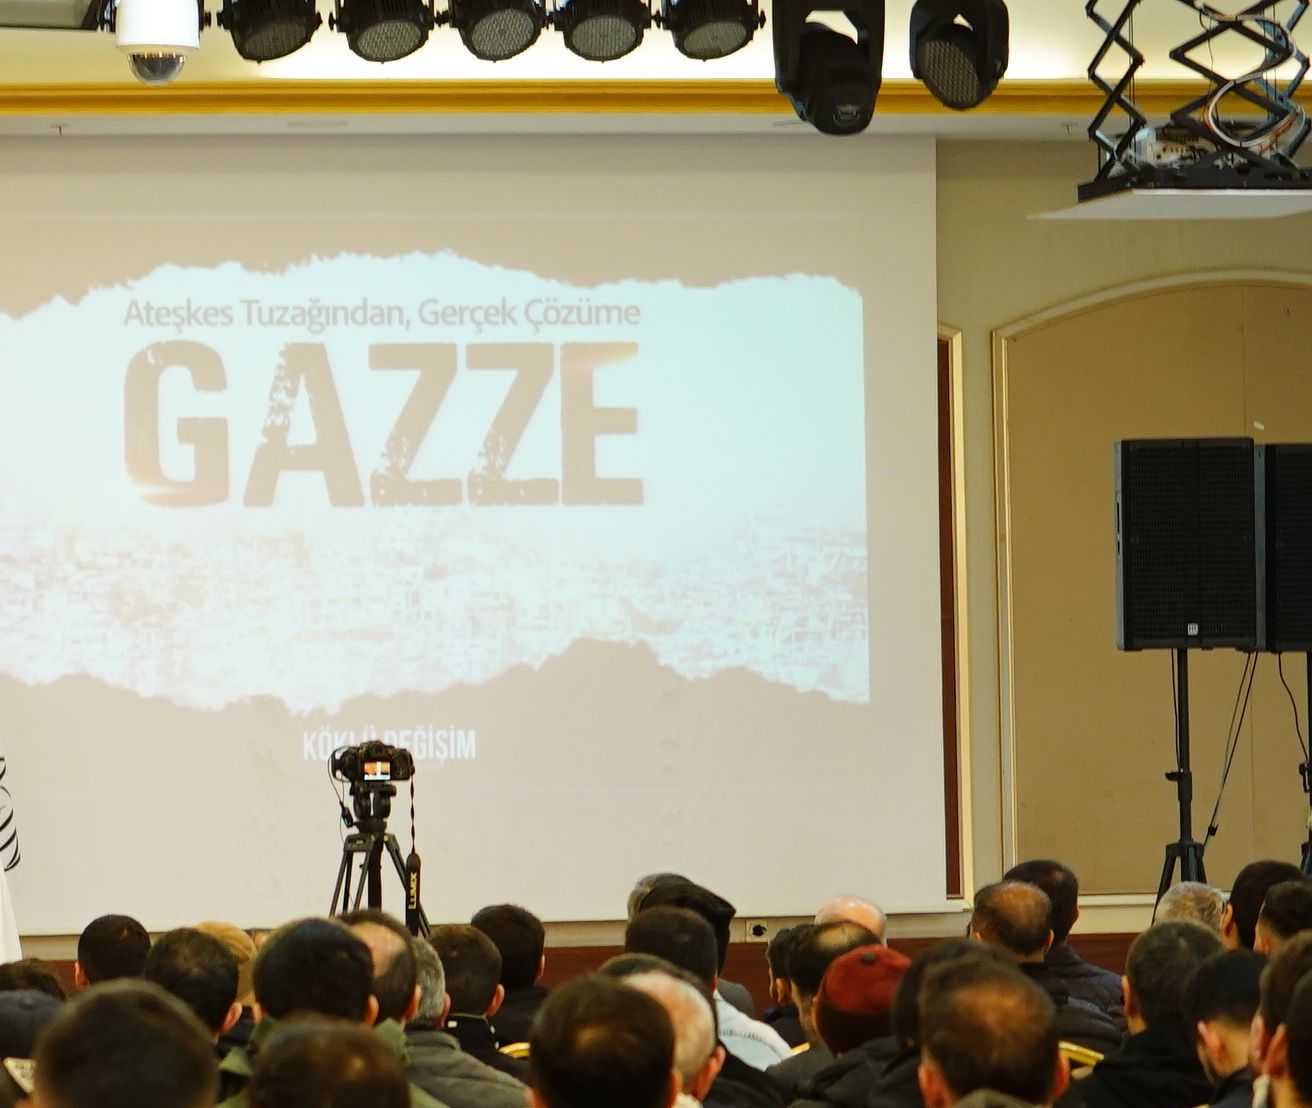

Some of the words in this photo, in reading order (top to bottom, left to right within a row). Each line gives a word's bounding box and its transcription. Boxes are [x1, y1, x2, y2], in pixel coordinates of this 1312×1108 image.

[124, 298, 233, 334] Ateşkes
[240, 298, 411, 333] Tuzağından,
[418, 298, 518, 332] Gerçek
[525, 298, 642, 333] Çözüme
[122, 340, 645, 508] GAZZE
